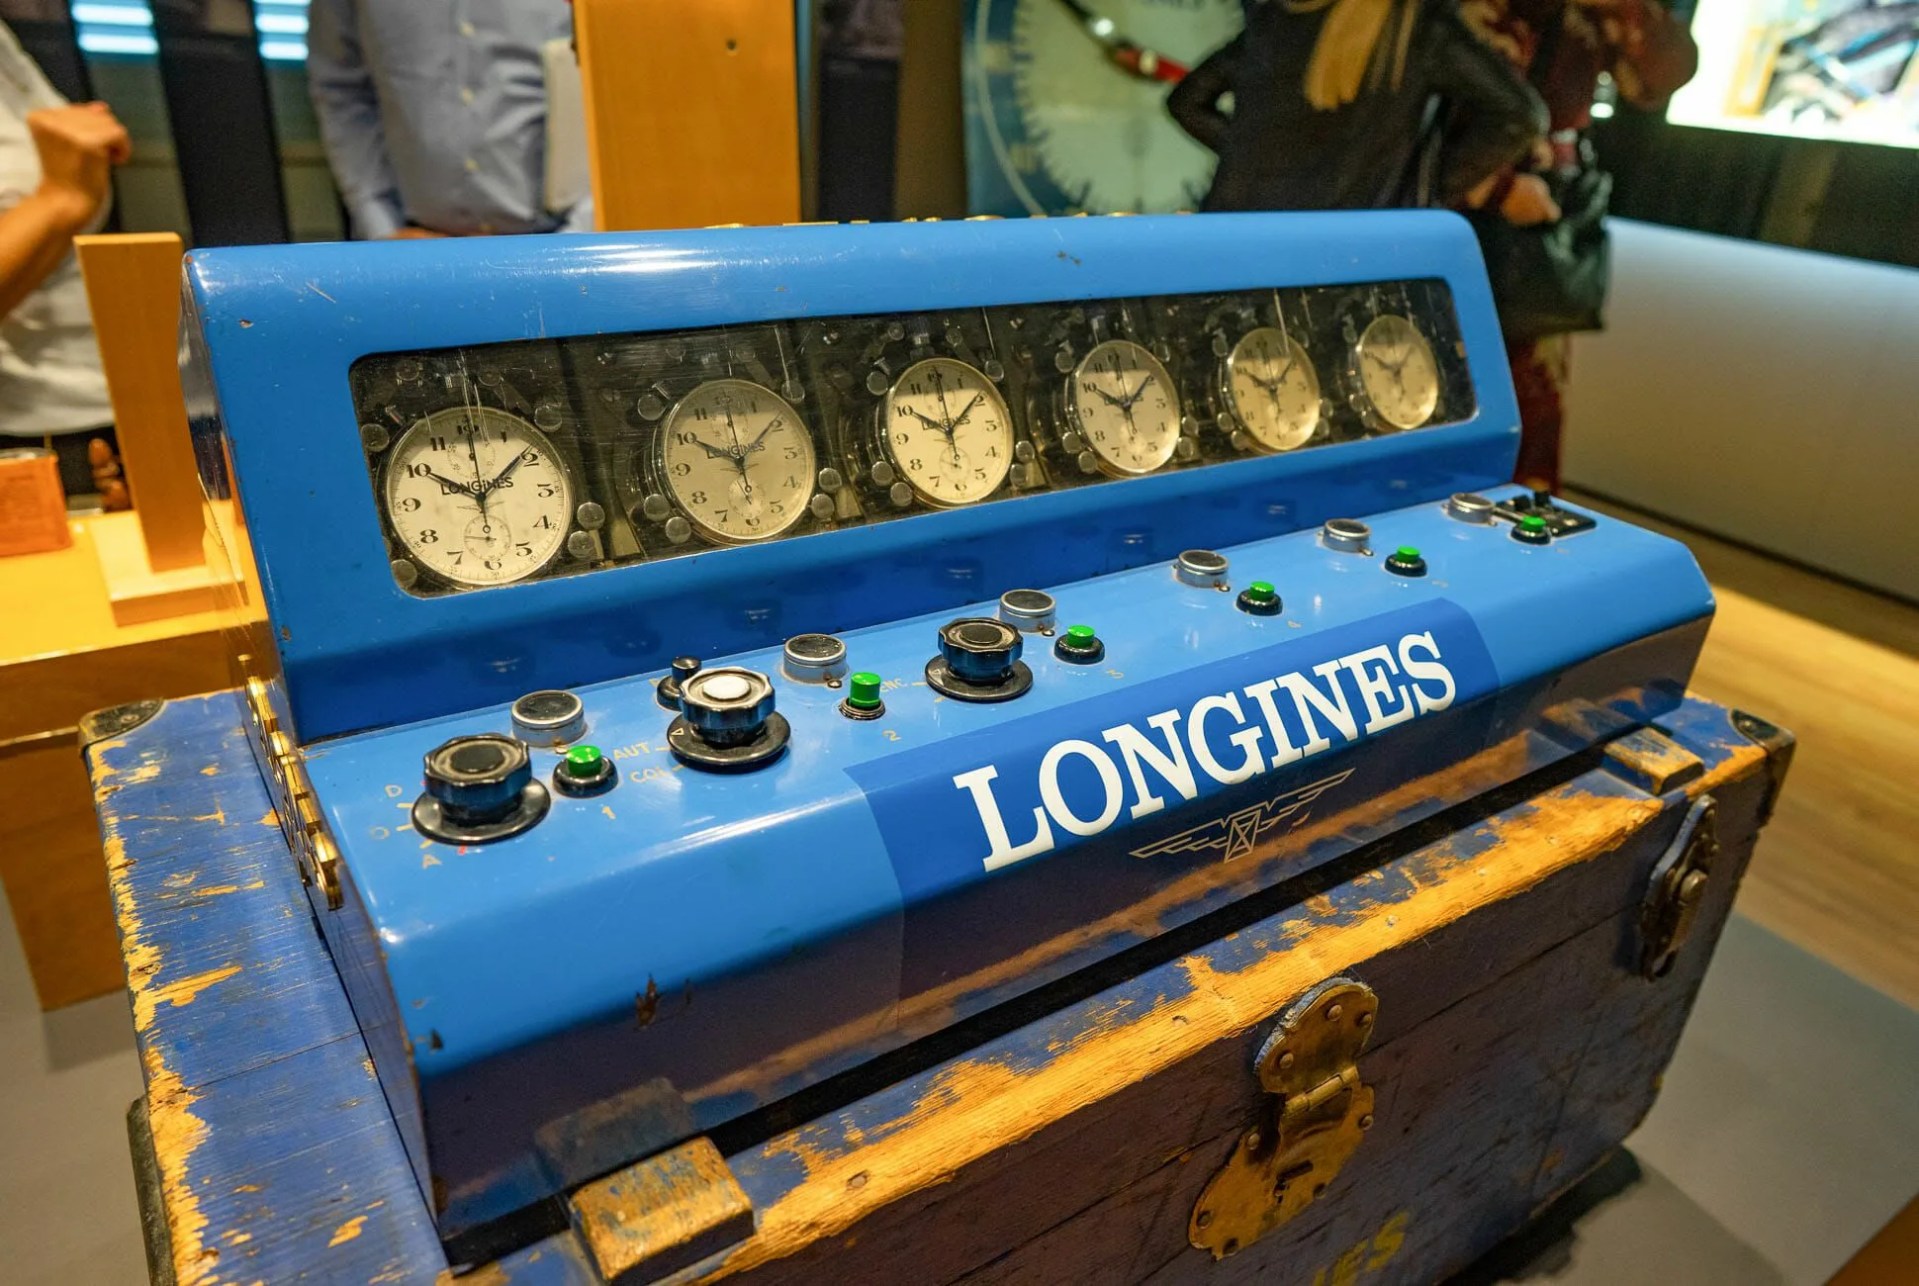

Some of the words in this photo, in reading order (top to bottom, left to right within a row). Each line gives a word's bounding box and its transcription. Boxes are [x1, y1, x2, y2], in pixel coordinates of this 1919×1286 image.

[910, 383, 921, 395] 11
[1083, 382, 1097, 393] 10
[694, 408, 707, 421] 11
[896, 405, 913, 417] 10
[770, 419, 783, 433] 2
[430, 436, 446, 451] 11
[501, 430, 507, 443] 1
[677, 432, 698, 446] 10
[896, 433, 909, 445] 9
[521, 452, 539, 467] 2
[909, 458, 923, 471] 8
[407, 463, 431, 478] 10
[675, 463, 691, 477] 9
[783, 475, 797, 488] 4
[929, 475, 941, 488] 7
[402, 497, 421, 512] 9
[691, 491, 707, 504] 8
[770, 500, 784, 513] 5
[533, 514, 549, 529] 4
[715, 509, 728, 523] 7
[420, 529, 439, 544] 8
[515, 541, 532, 557] 5
[446, 550, 463, 565] 7
[613, 742, 651, 760] AUT
[953, 630, 1457, 873] LONGINES
[422, 853, 442, 870] A
